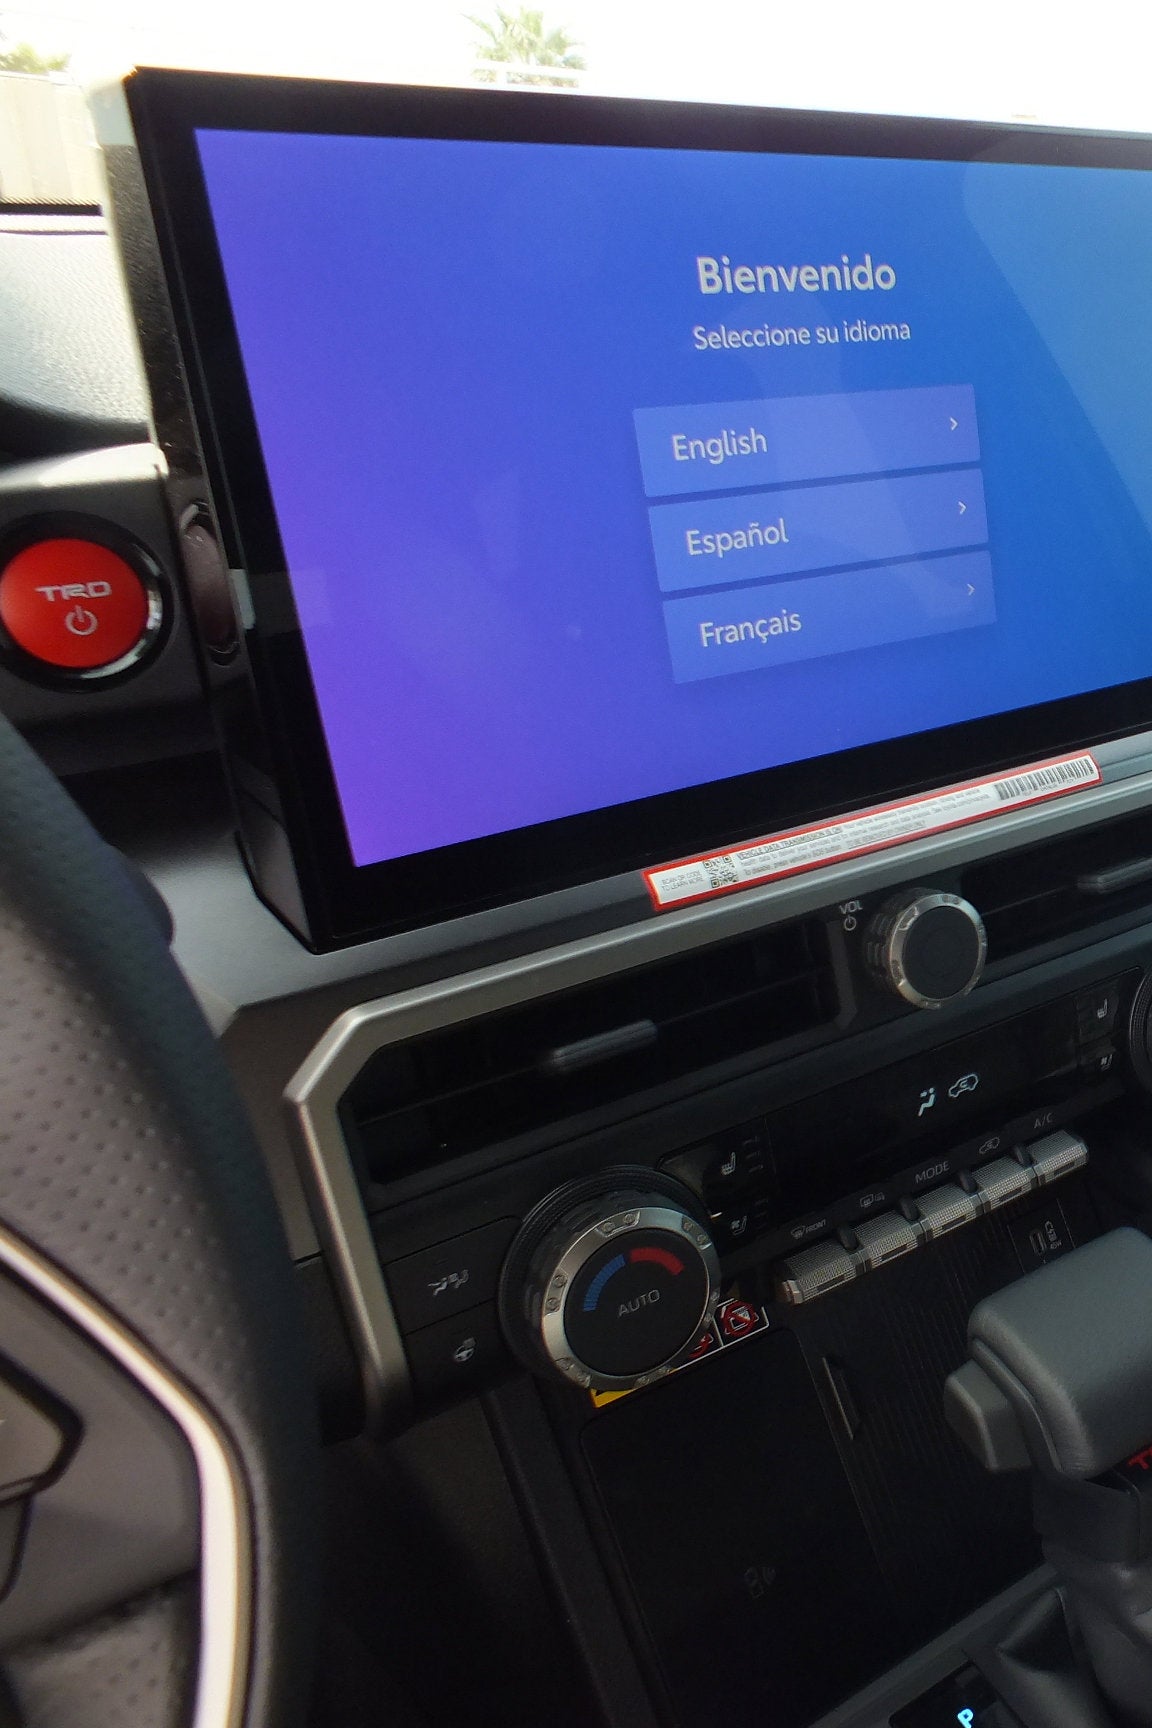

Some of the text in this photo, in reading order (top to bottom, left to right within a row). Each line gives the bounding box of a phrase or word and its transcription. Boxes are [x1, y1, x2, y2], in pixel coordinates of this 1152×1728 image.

[696, 254, 897, 295] Bienvenido
[693, 320, 911, 351] Seleccione su idioma
[672, 428, 768, 464] English
[686, 518, 789, 557] Español
[35, 581, 112, 602] TRD
[700, 609, 803, 647] Français
[737, 848, 765, 860] VEHICLE
[764, 842, 782, 854] DATA
[839, 900, 863, 914] VOL
[1033, 1112, 1054, 1129] A/C
[915, 1160, 950, 1184] MODE
[617, 1289, 660, 1317] AUTO
[957, 1708, 974, 1728] P
